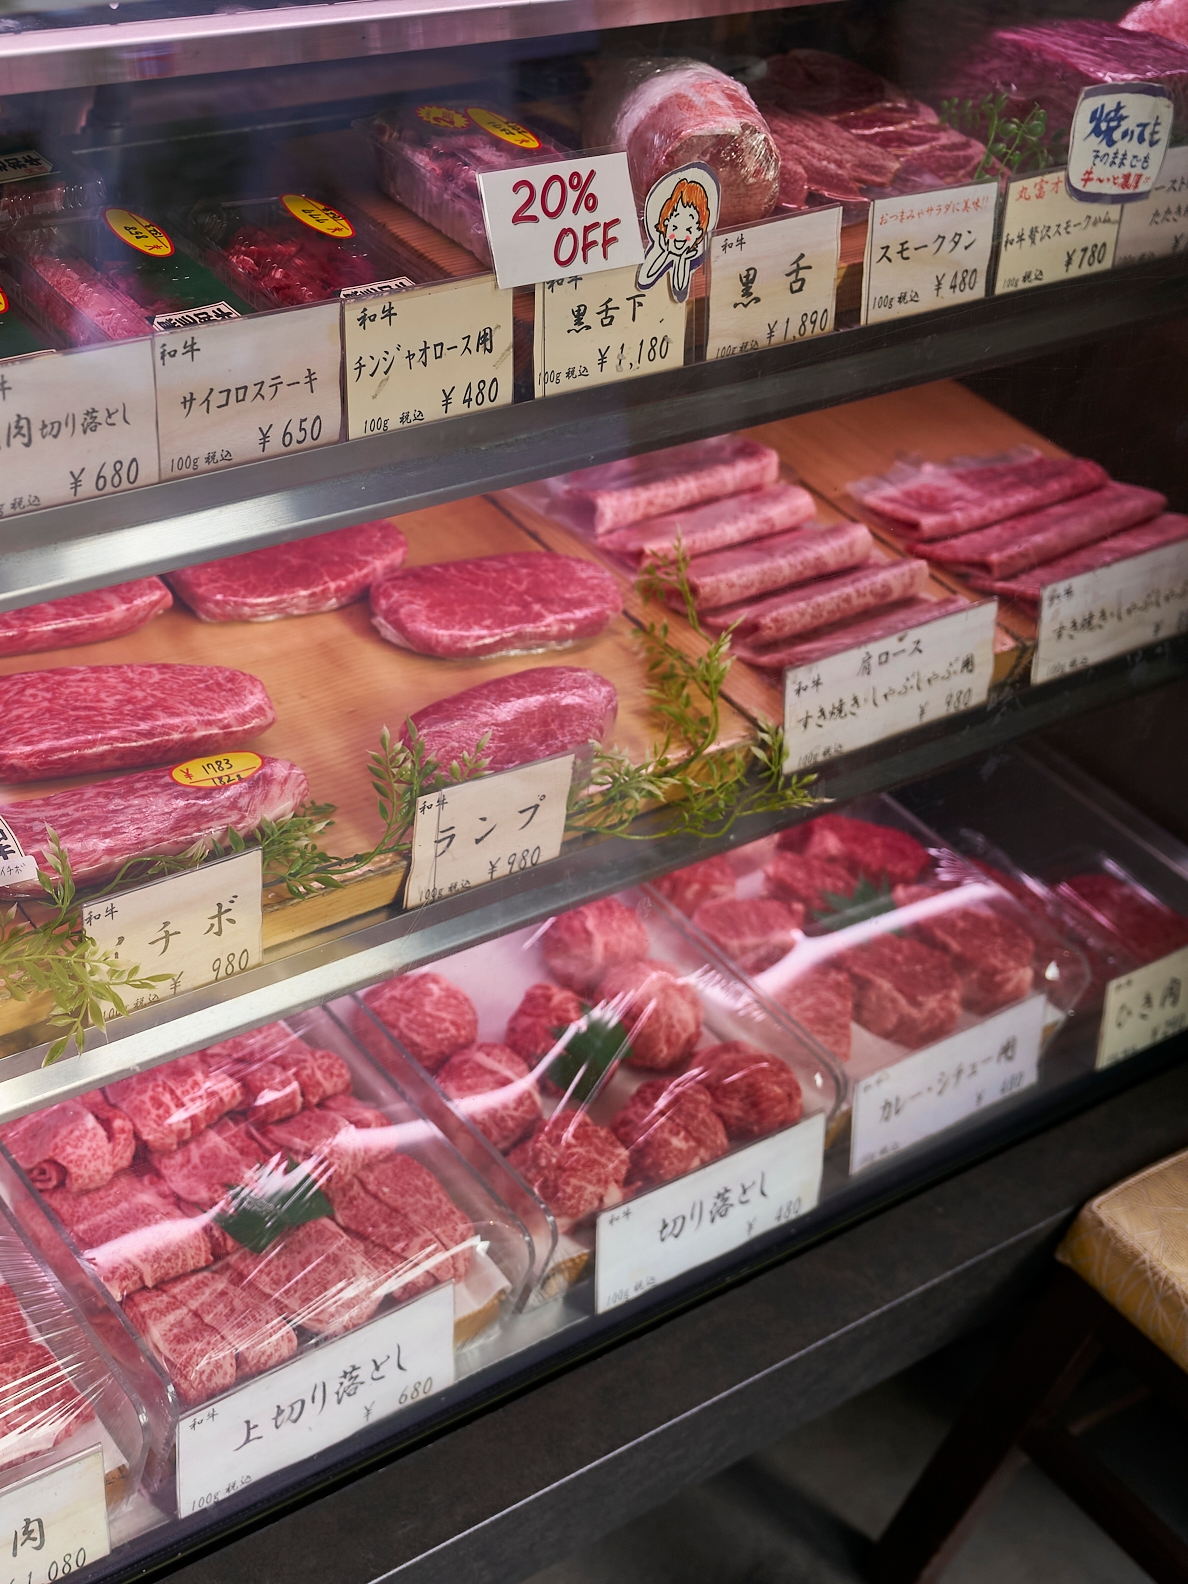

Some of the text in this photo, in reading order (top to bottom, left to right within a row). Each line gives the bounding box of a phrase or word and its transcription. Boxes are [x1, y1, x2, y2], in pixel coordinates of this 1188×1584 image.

[1083, 100, 1161, 148] 焼いても
[1092, 148, 1150, 170] そのままでも
[511, 168, 599, 226] 20%
[553, 217, 622, 268] OFF
[721, 233, 746, 254] 和牛
[876, 230, 977, 264] スモークタン
[1064, 242, 1107, 273] ¥780
[733, 252, 813, 309] 黒舌
[934, 268, 978, 298] ¥480
[356, 301, 398, 331] 和牛
[566, 294, 646, 335] 黒舌下
[872, 290, 920, 310] 100g 税込
[766, 308, 829, 347] ¥1,890
[160, 336, 201, 366] 和牛
[353, 326, 494, 383] チンジャオロース用
[597, 334, 673, 373] ¥1,180
[538, 365, 590, 386] 100g 税込
[180, 368, 318, 419] サイコロステーキ
[441, 376, 499, 415] ¥480
[258, 415, 322, 453] ¥650
[363, 409, 425, 434] 100g 税込
[69, 457, 139, 497] ¥680
[170, 449, 233, 473] 100g 税込
[10, 494, 42, 511] 税込
[857, 638, 923, 677] 肩ロース
[794, 674, 823, 698] 和牛
[419, 795, 448, 815] 和牛
[434, 794, 546, 858] ランプ
[488, 846, 541, 880] ¥980
[448, 879, 471, 893] 税込
[84, 903, 119, 926] 和牛
[102, 894, 239, 962] チボ
[133, 993, 160, 1010] 税込
[608, 1207, 632, 1226] 和牛
[657, 1170, 768, 1243] 切り落とし
[232, 1343, 407, 1452] 上切り落とし
[189, 1408, 218, 1430] 和牛
[191, 1474, 252, 1512] 100g 税込
